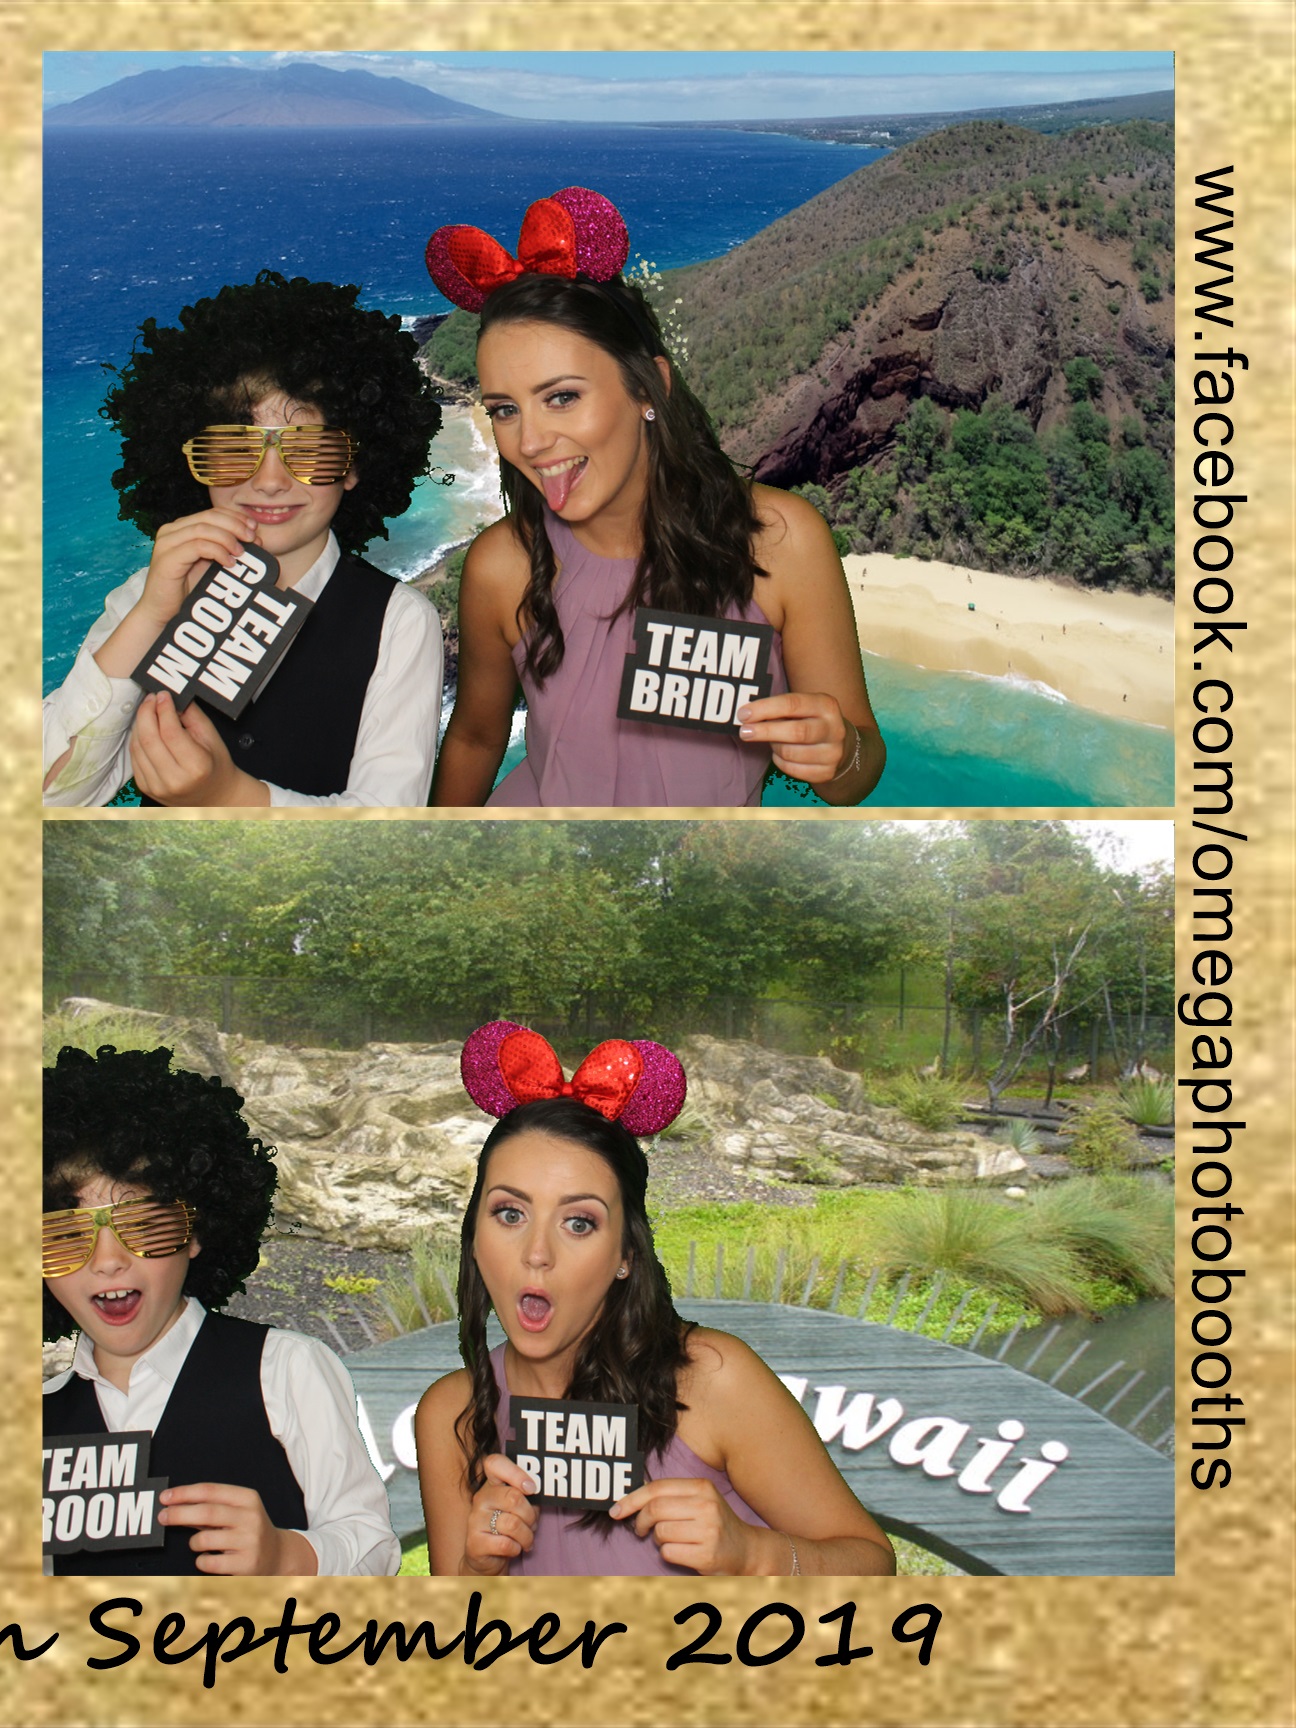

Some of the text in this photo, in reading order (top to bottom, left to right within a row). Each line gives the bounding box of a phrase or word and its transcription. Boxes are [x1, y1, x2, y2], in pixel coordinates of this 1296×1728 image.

[146, 551, 267, 695] GROOM
[198, 591, 297, 702] TEAM
[646, 622, 760, 680] TEAM
[521, 1409, 627, 1458] TEAM
[516, 1454, 633, 1502] BRIDE
